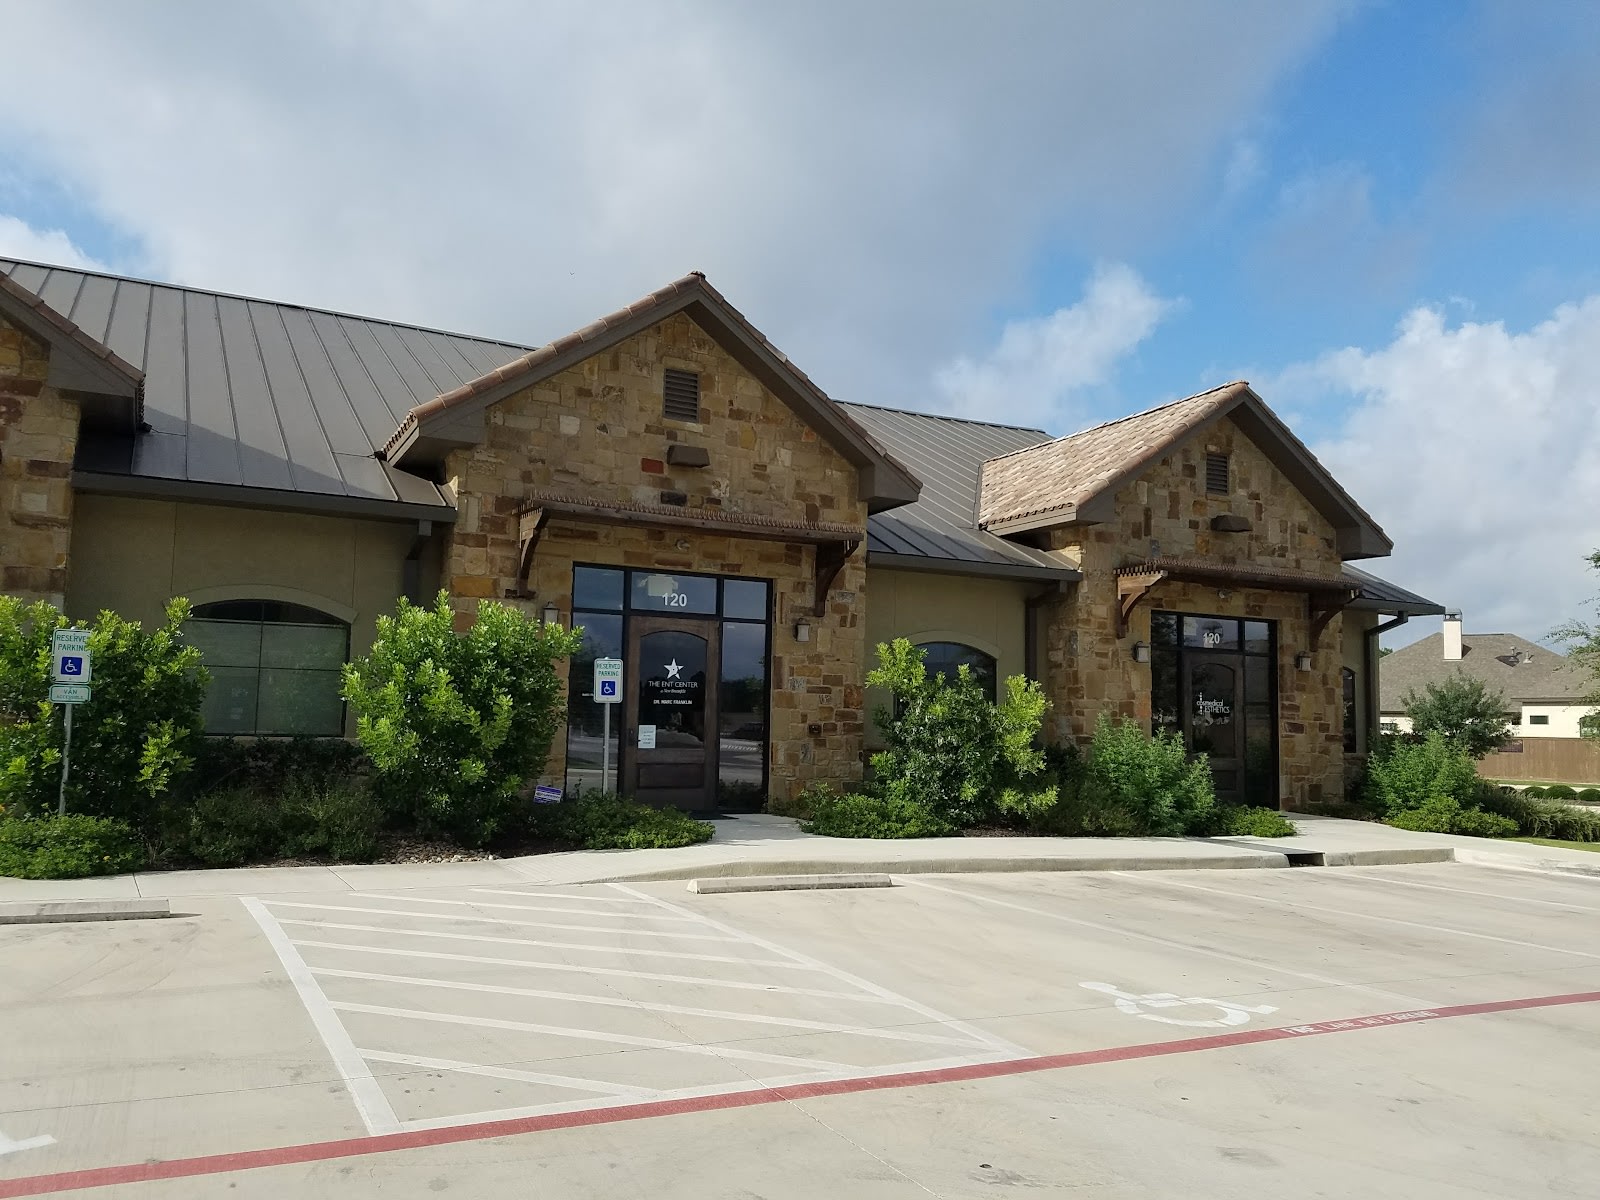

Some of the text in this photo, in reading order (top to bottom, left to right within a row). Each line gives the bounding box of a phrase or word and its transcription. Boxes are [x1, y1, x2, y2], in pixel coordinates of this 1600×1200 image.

[662, 592, 688, 608] 120
[56, 634, 88, 643] RESERVE
[1203, 632, 1221, 644] 120
[648, 680, 661, 688] THE
[1204, 706, 1230, 714] ESTHETICS
